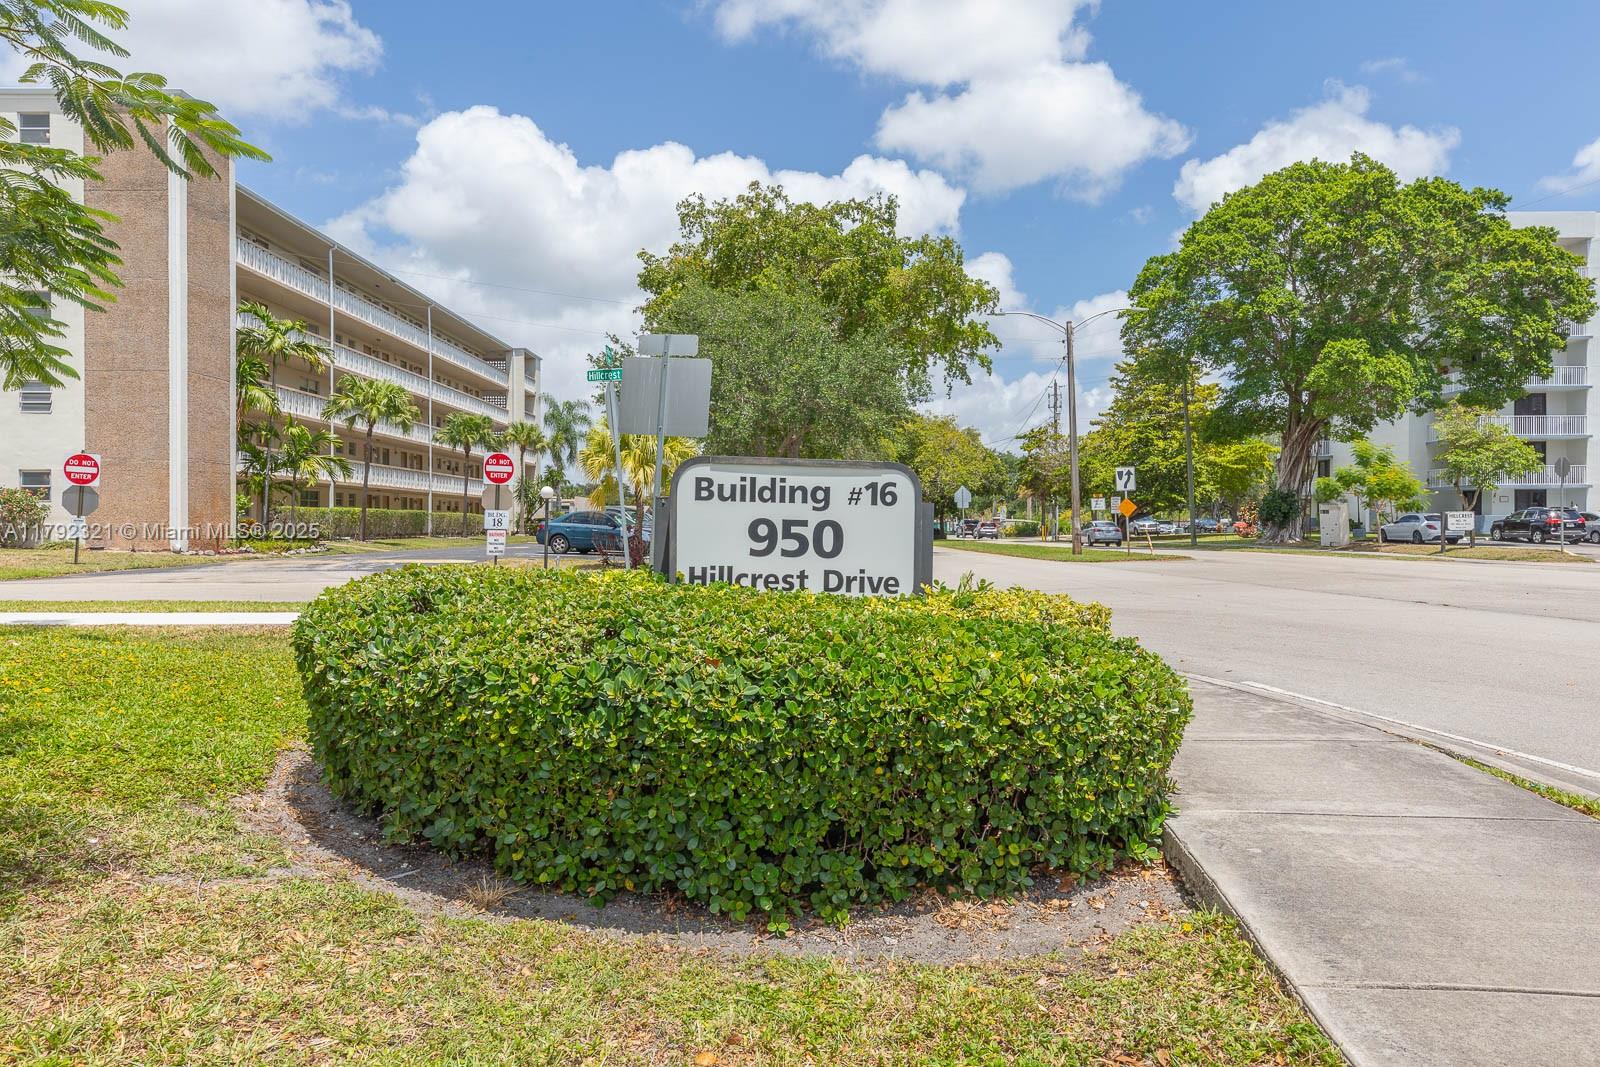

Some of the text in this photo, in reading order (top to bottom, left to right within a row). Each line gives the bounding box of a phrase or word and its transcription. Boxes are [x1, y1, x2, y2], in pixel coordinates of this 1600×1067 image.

[588, 371, 621, 380] Hillcrest
[694, 476, 898, 511] Building #16
[492, 517, 503, 527] 18
[747, 517, 844, 559] 950
[688, 565, 900, 594] Hillcrest Drive
